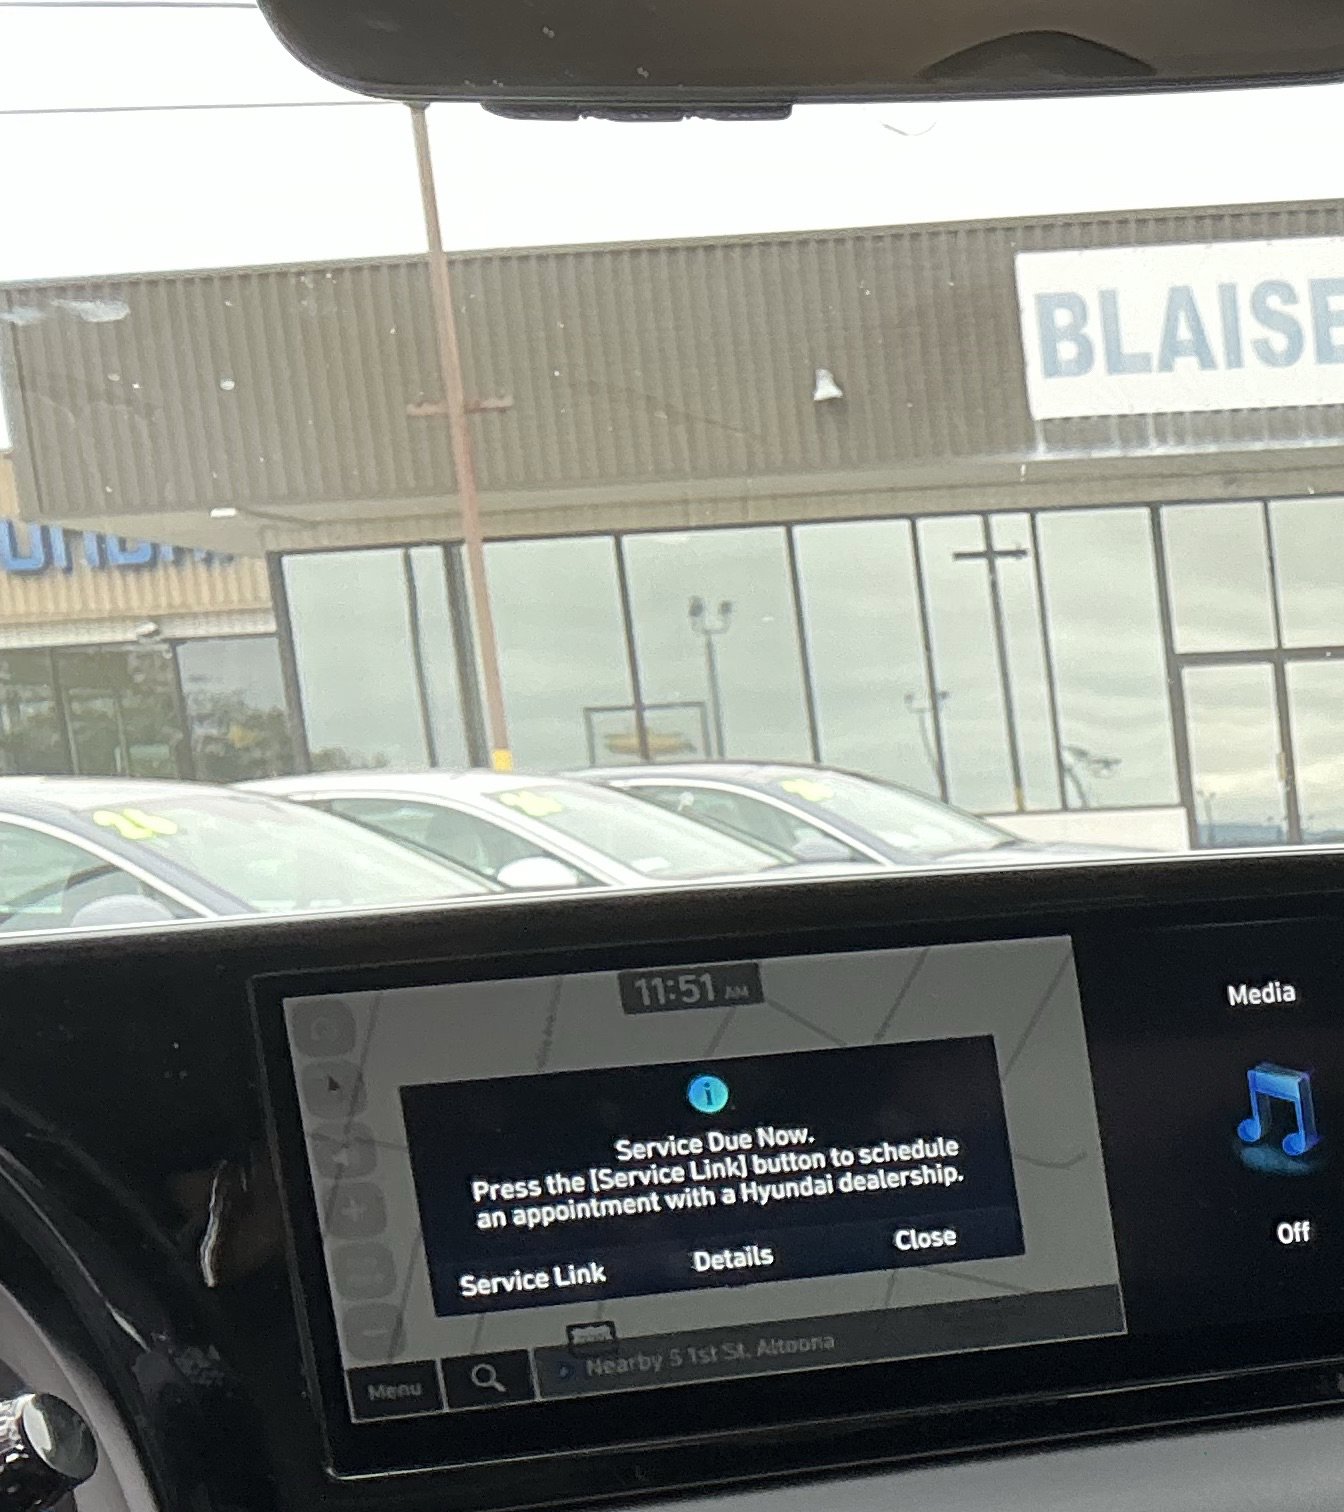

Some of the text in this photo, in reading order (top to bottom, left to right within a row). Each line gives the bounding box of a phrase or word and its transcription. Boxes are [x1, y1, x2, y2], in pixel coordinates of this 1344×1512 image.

[0, 519, 236, 572] UND
[634, 973, 749, 1006] 11:51 AM
[1227, 980, 1297, 1007] Media
[615, 1126, 816, 1161] Service Due Now.
[471, 1137, 960, 1202] Press the [Service Link] button to schedule
[476, 1163, 964, 1230] an appointment with a Hyundai dealership.
[894, 1228, 957, 1251] Close
[1277, 1221, 1311, 1245] Off
[693, 1244, 775, 1272] Details
[459, 1261, 607, 1298] Service Link
[586, 1350, 663, 1377] Nearby
[757, 1334, 836, 1357] Altoona
[368, 1379, 422, 1400] Menu
